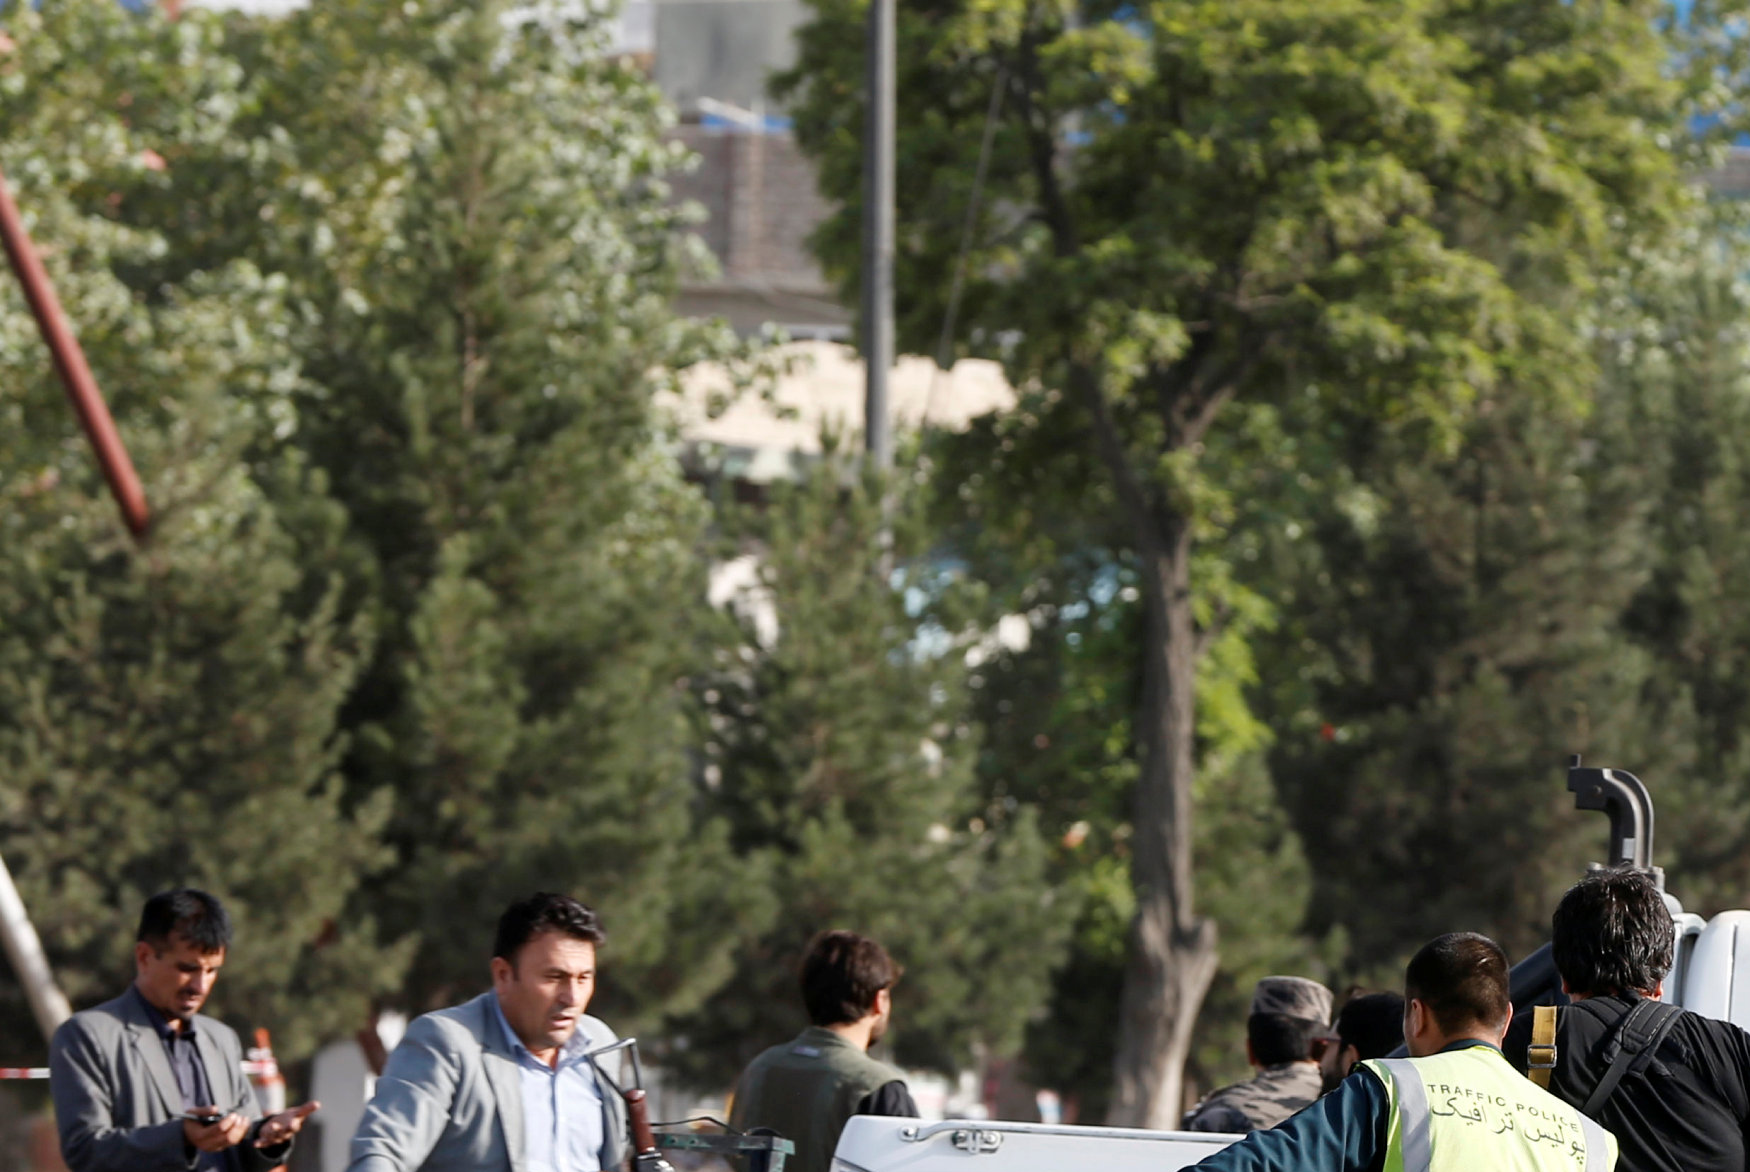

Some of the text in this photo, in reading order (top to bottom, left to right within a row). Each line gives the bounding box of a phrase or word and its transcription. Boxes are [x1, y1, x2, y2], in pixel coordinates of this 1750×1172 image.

[1427, 1084, 1578, 1133] TRAFFIC POLICE
[1432, 1097, 1585, 1165] پولیس ترافیک
